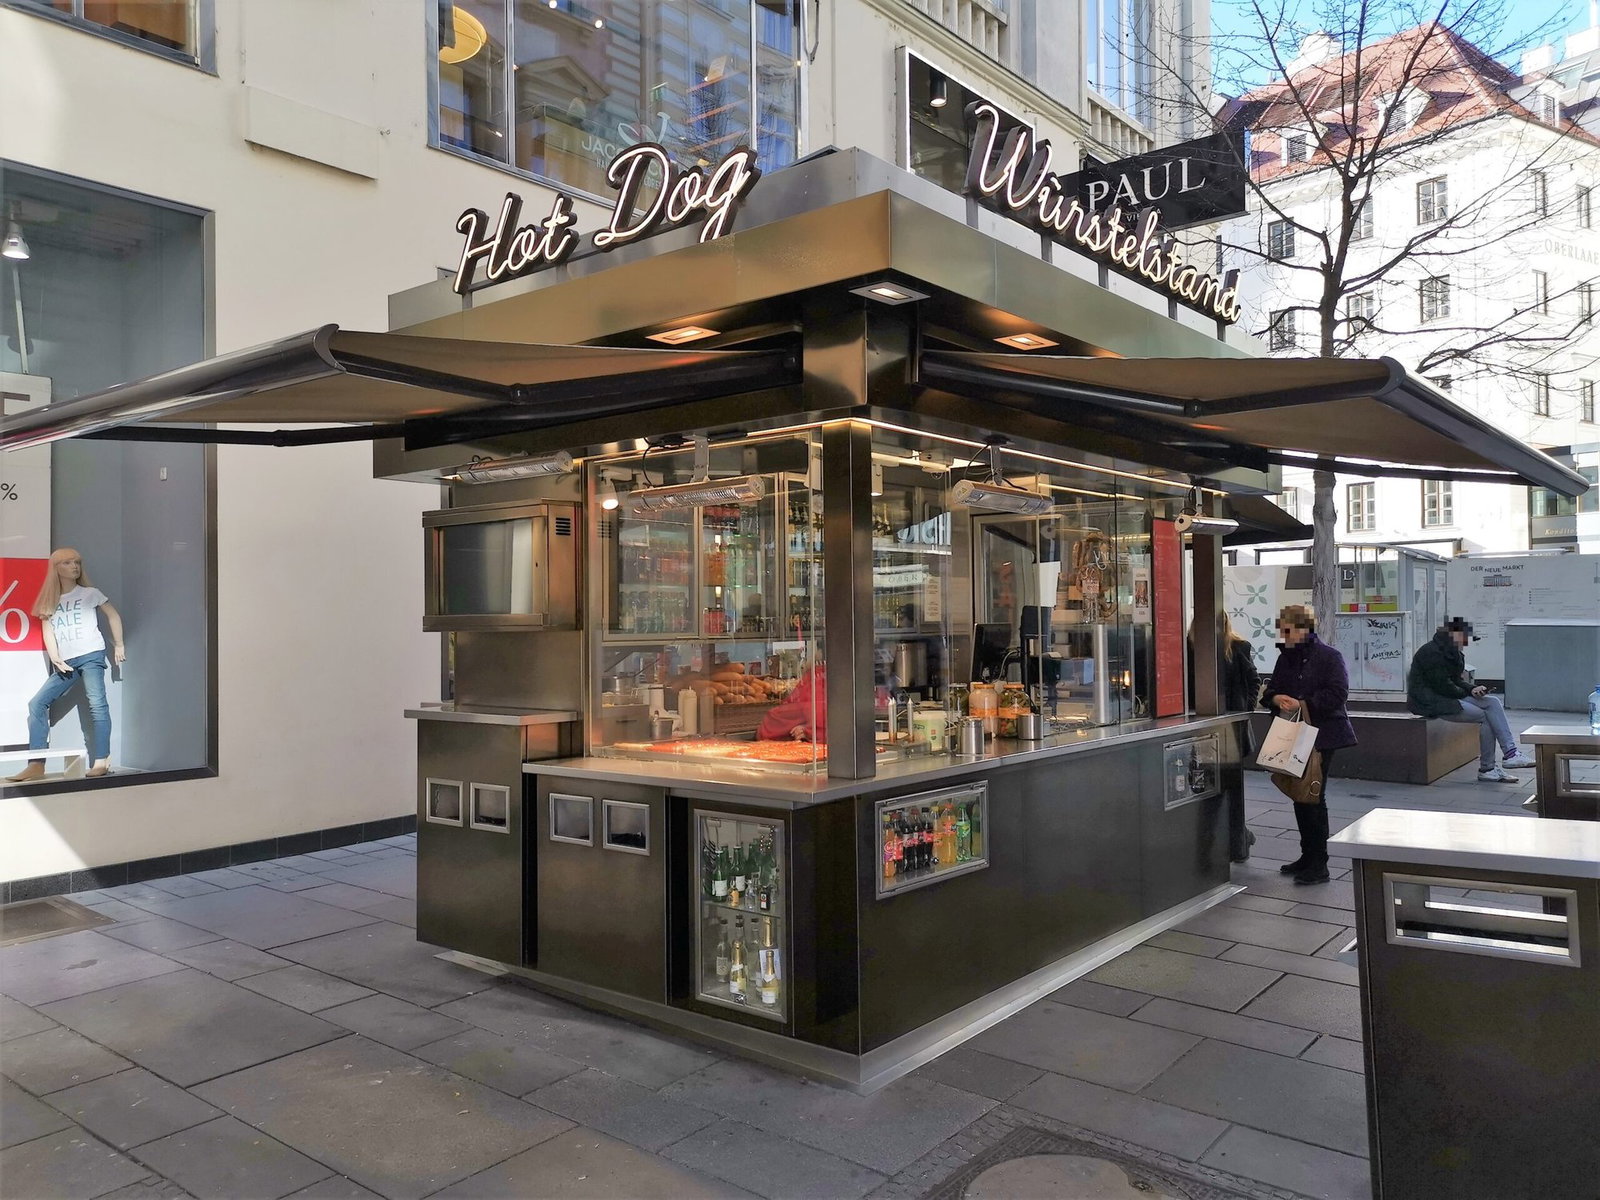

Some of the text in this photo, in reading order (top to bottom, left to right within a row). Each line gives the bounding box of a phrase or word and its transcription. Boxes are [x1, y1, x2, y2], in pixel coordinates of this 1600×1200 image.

[1085, 157, 1206, 212] PAUL
[453, 142, 760, 294] Hot Dog
[54, 598, 83, 615] ALE
[59, 627, 84, 643] ALE
